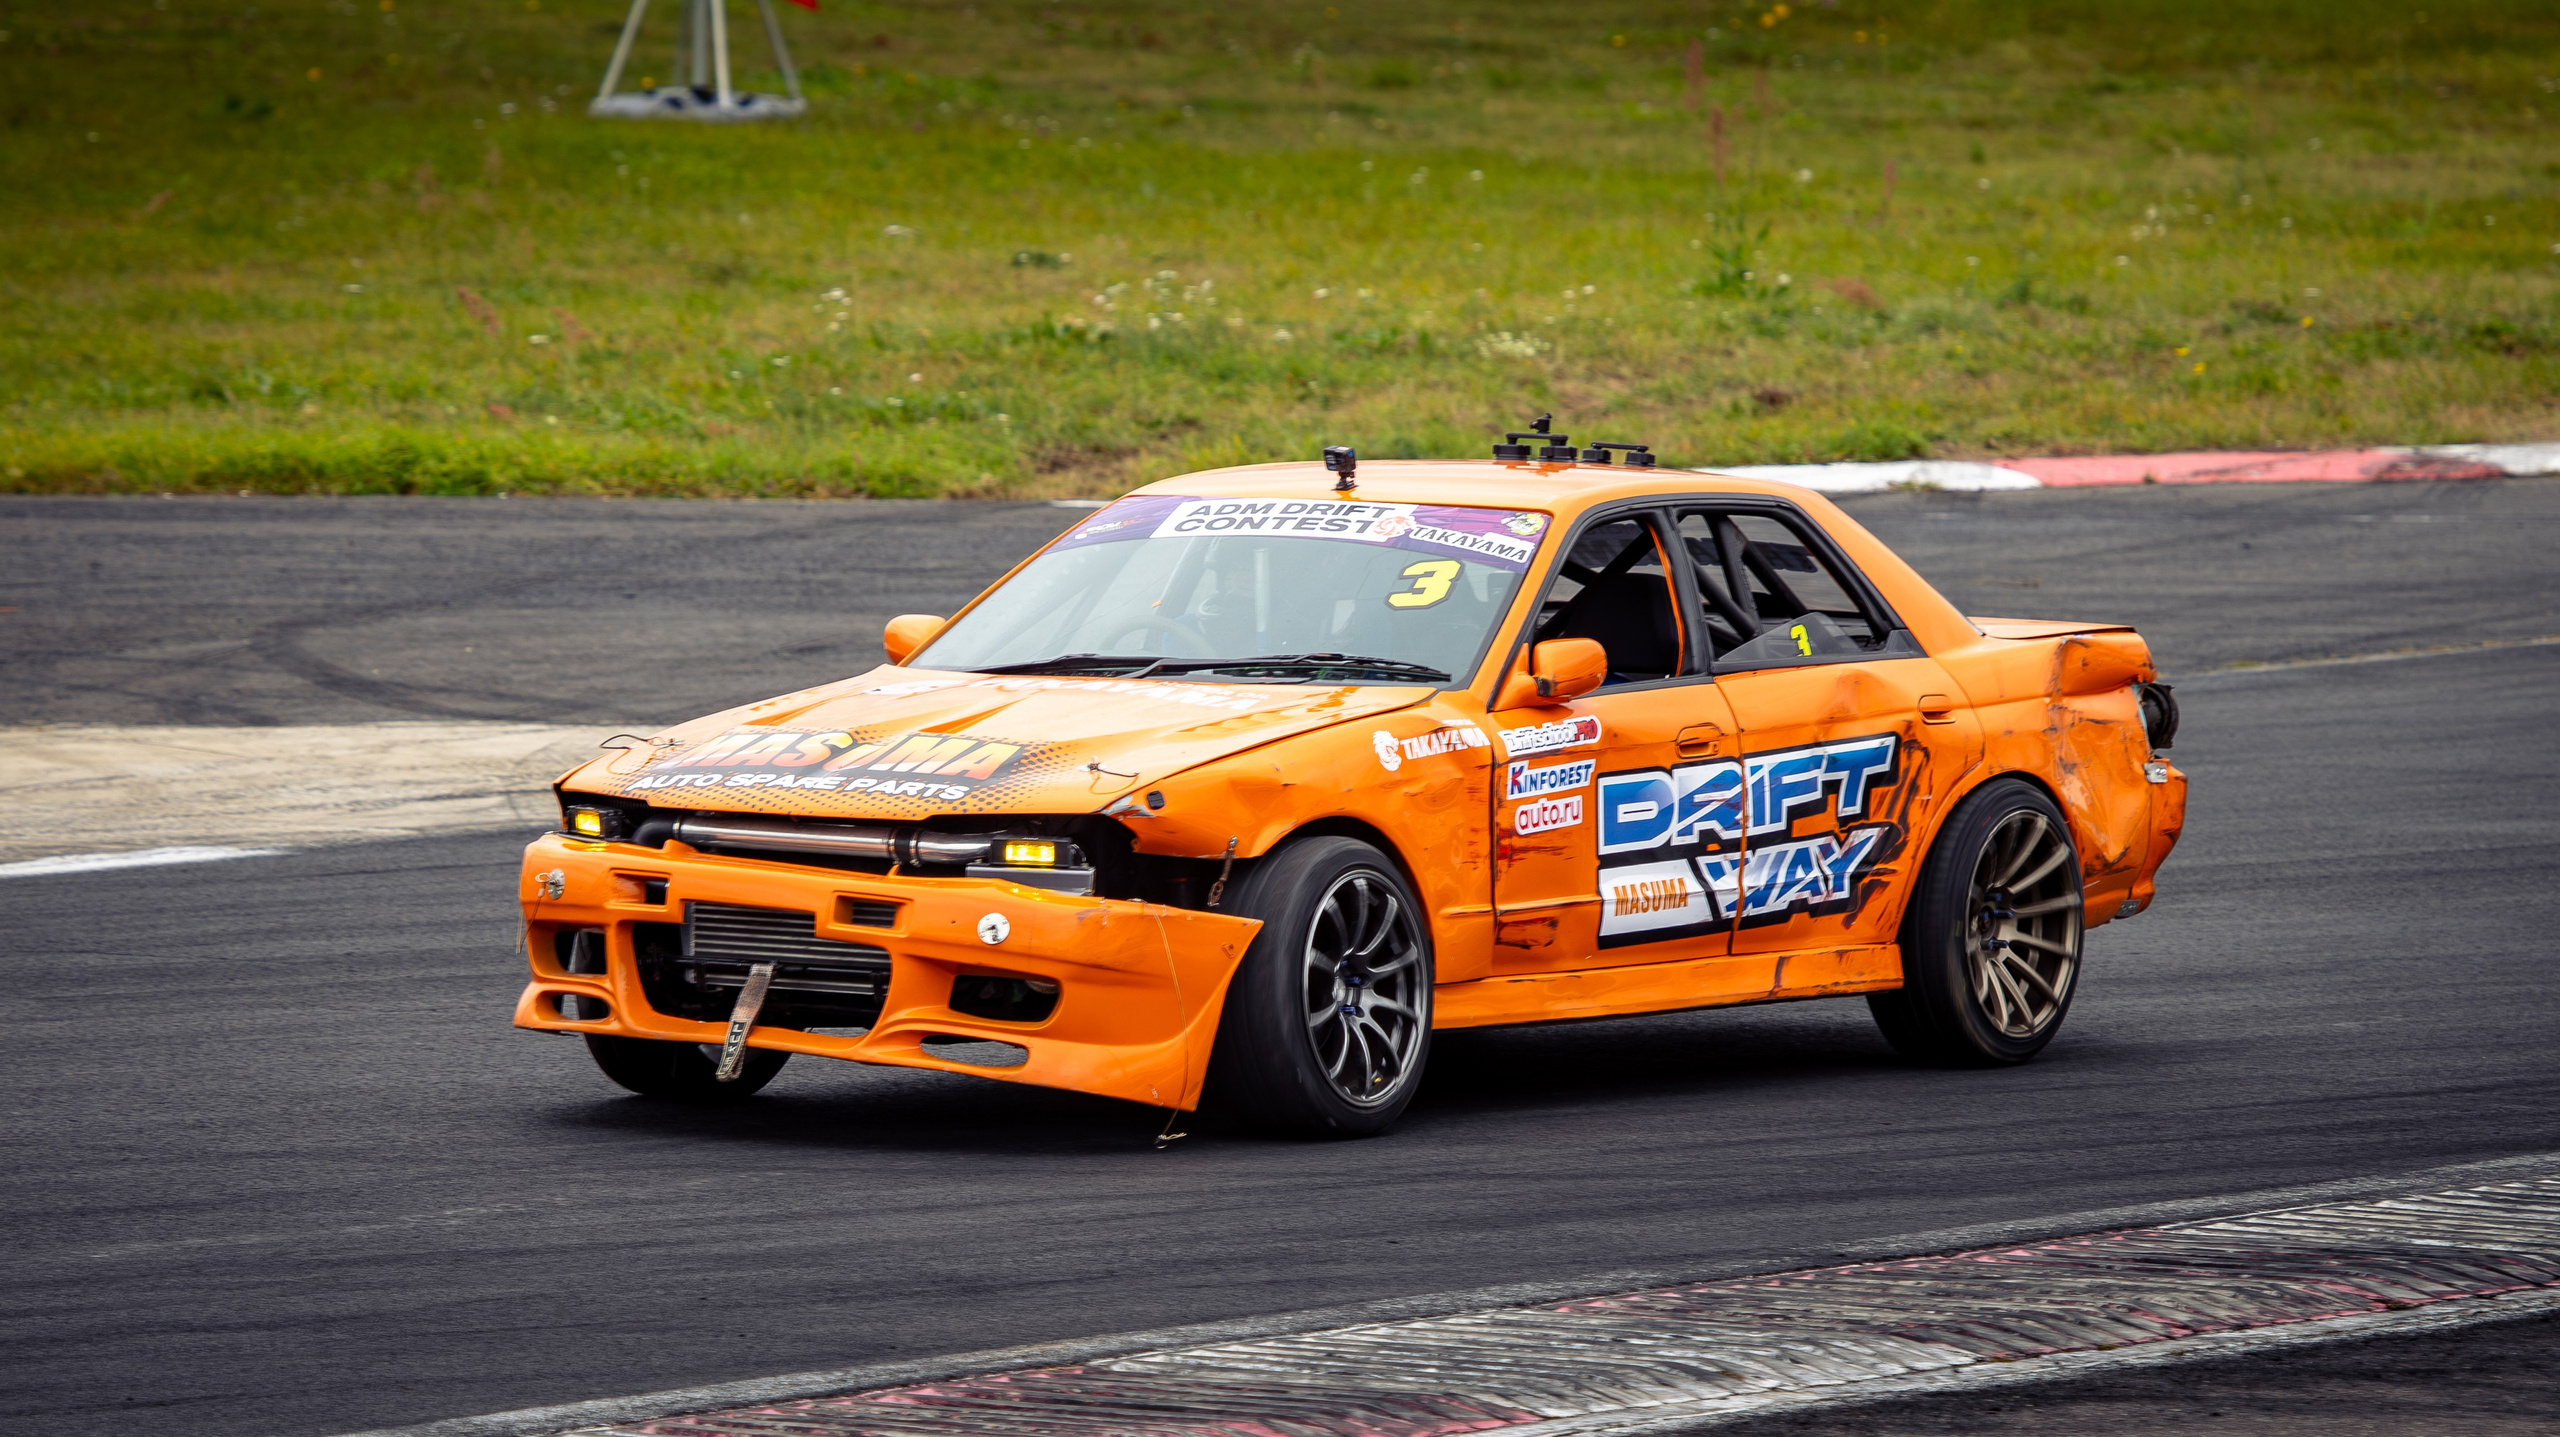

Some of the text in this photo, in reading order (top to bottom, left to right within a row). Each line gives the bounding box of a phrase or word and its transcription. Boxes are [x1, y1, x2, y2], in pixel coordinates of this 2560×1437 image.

[1173, 516, 1375, 534] CONTEST
[1187, 502, 1396, 519] ADM DRIFT
[1411, 526, 1528, 561] TAKAYAMA
[1386, 558, 1463, 609] 3
[1790, 624, 1812, 657] 3
[652, 732, 1022, 781] MASUMA
[626, 773, 971, 800] AUTO SPARE PARTS
[1510, 763, 1593, 796] KINFOREST
[1598, 736, 1896, 855] DRIFT
[1518, 800, 1581, 831] auto.ru
[1696, 826, 1890, 919] WAY
[1613, 877, 1690, 917] MASUMA
